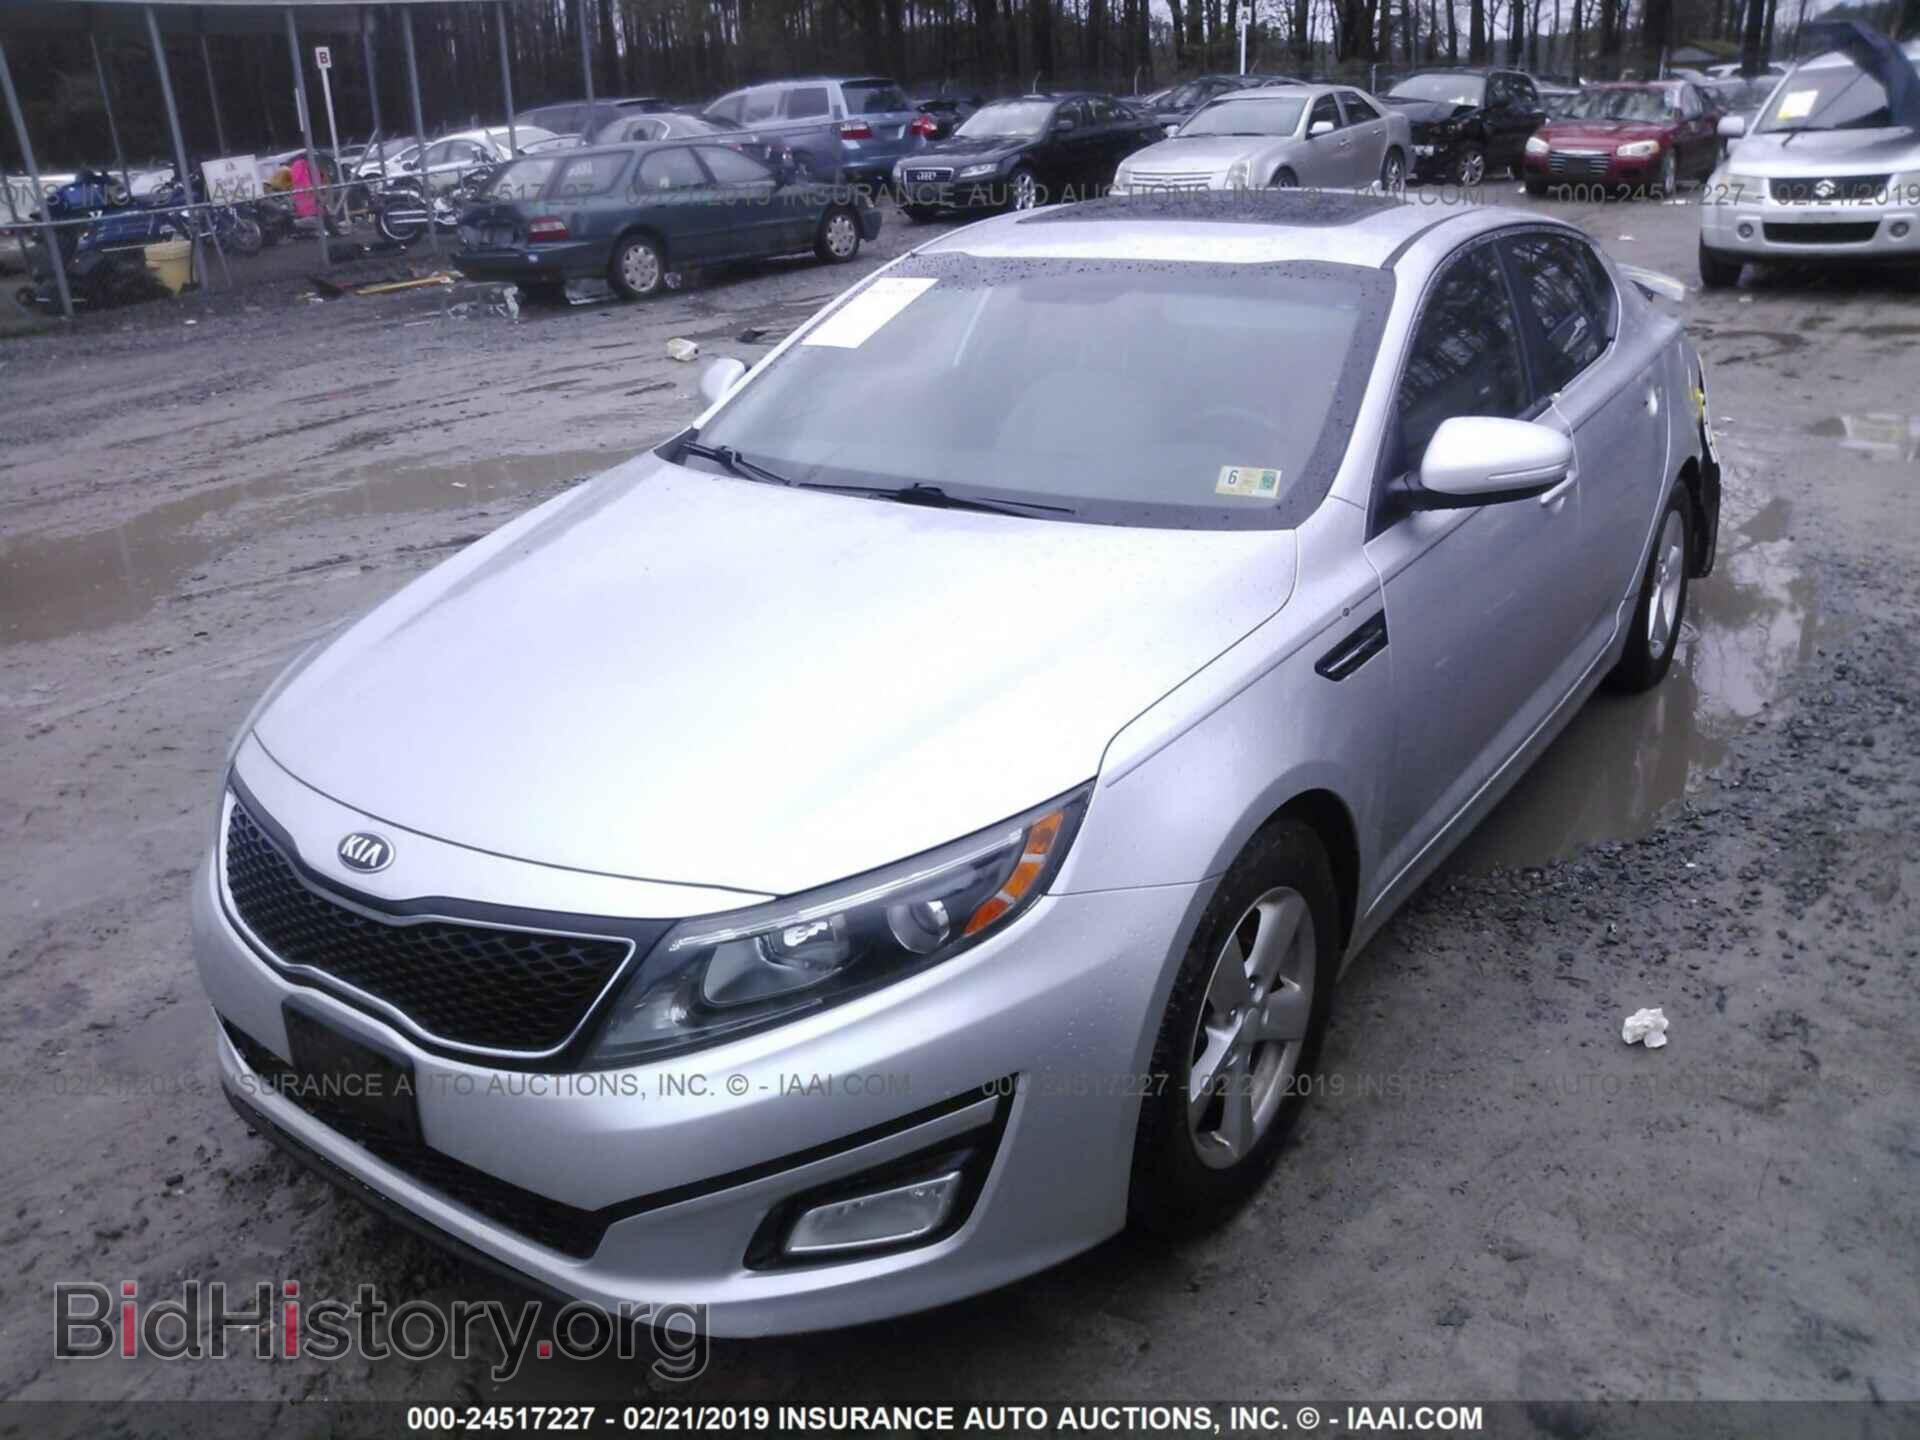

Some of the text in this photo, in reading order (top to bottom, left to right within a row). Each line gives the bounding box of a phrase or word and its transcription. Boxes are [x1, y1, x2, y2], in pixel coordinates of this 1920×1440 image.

[319, 51, 329, 64] B
[1228, 470, 1239, 485] 6
[341, 834, 383, 867] KIA
